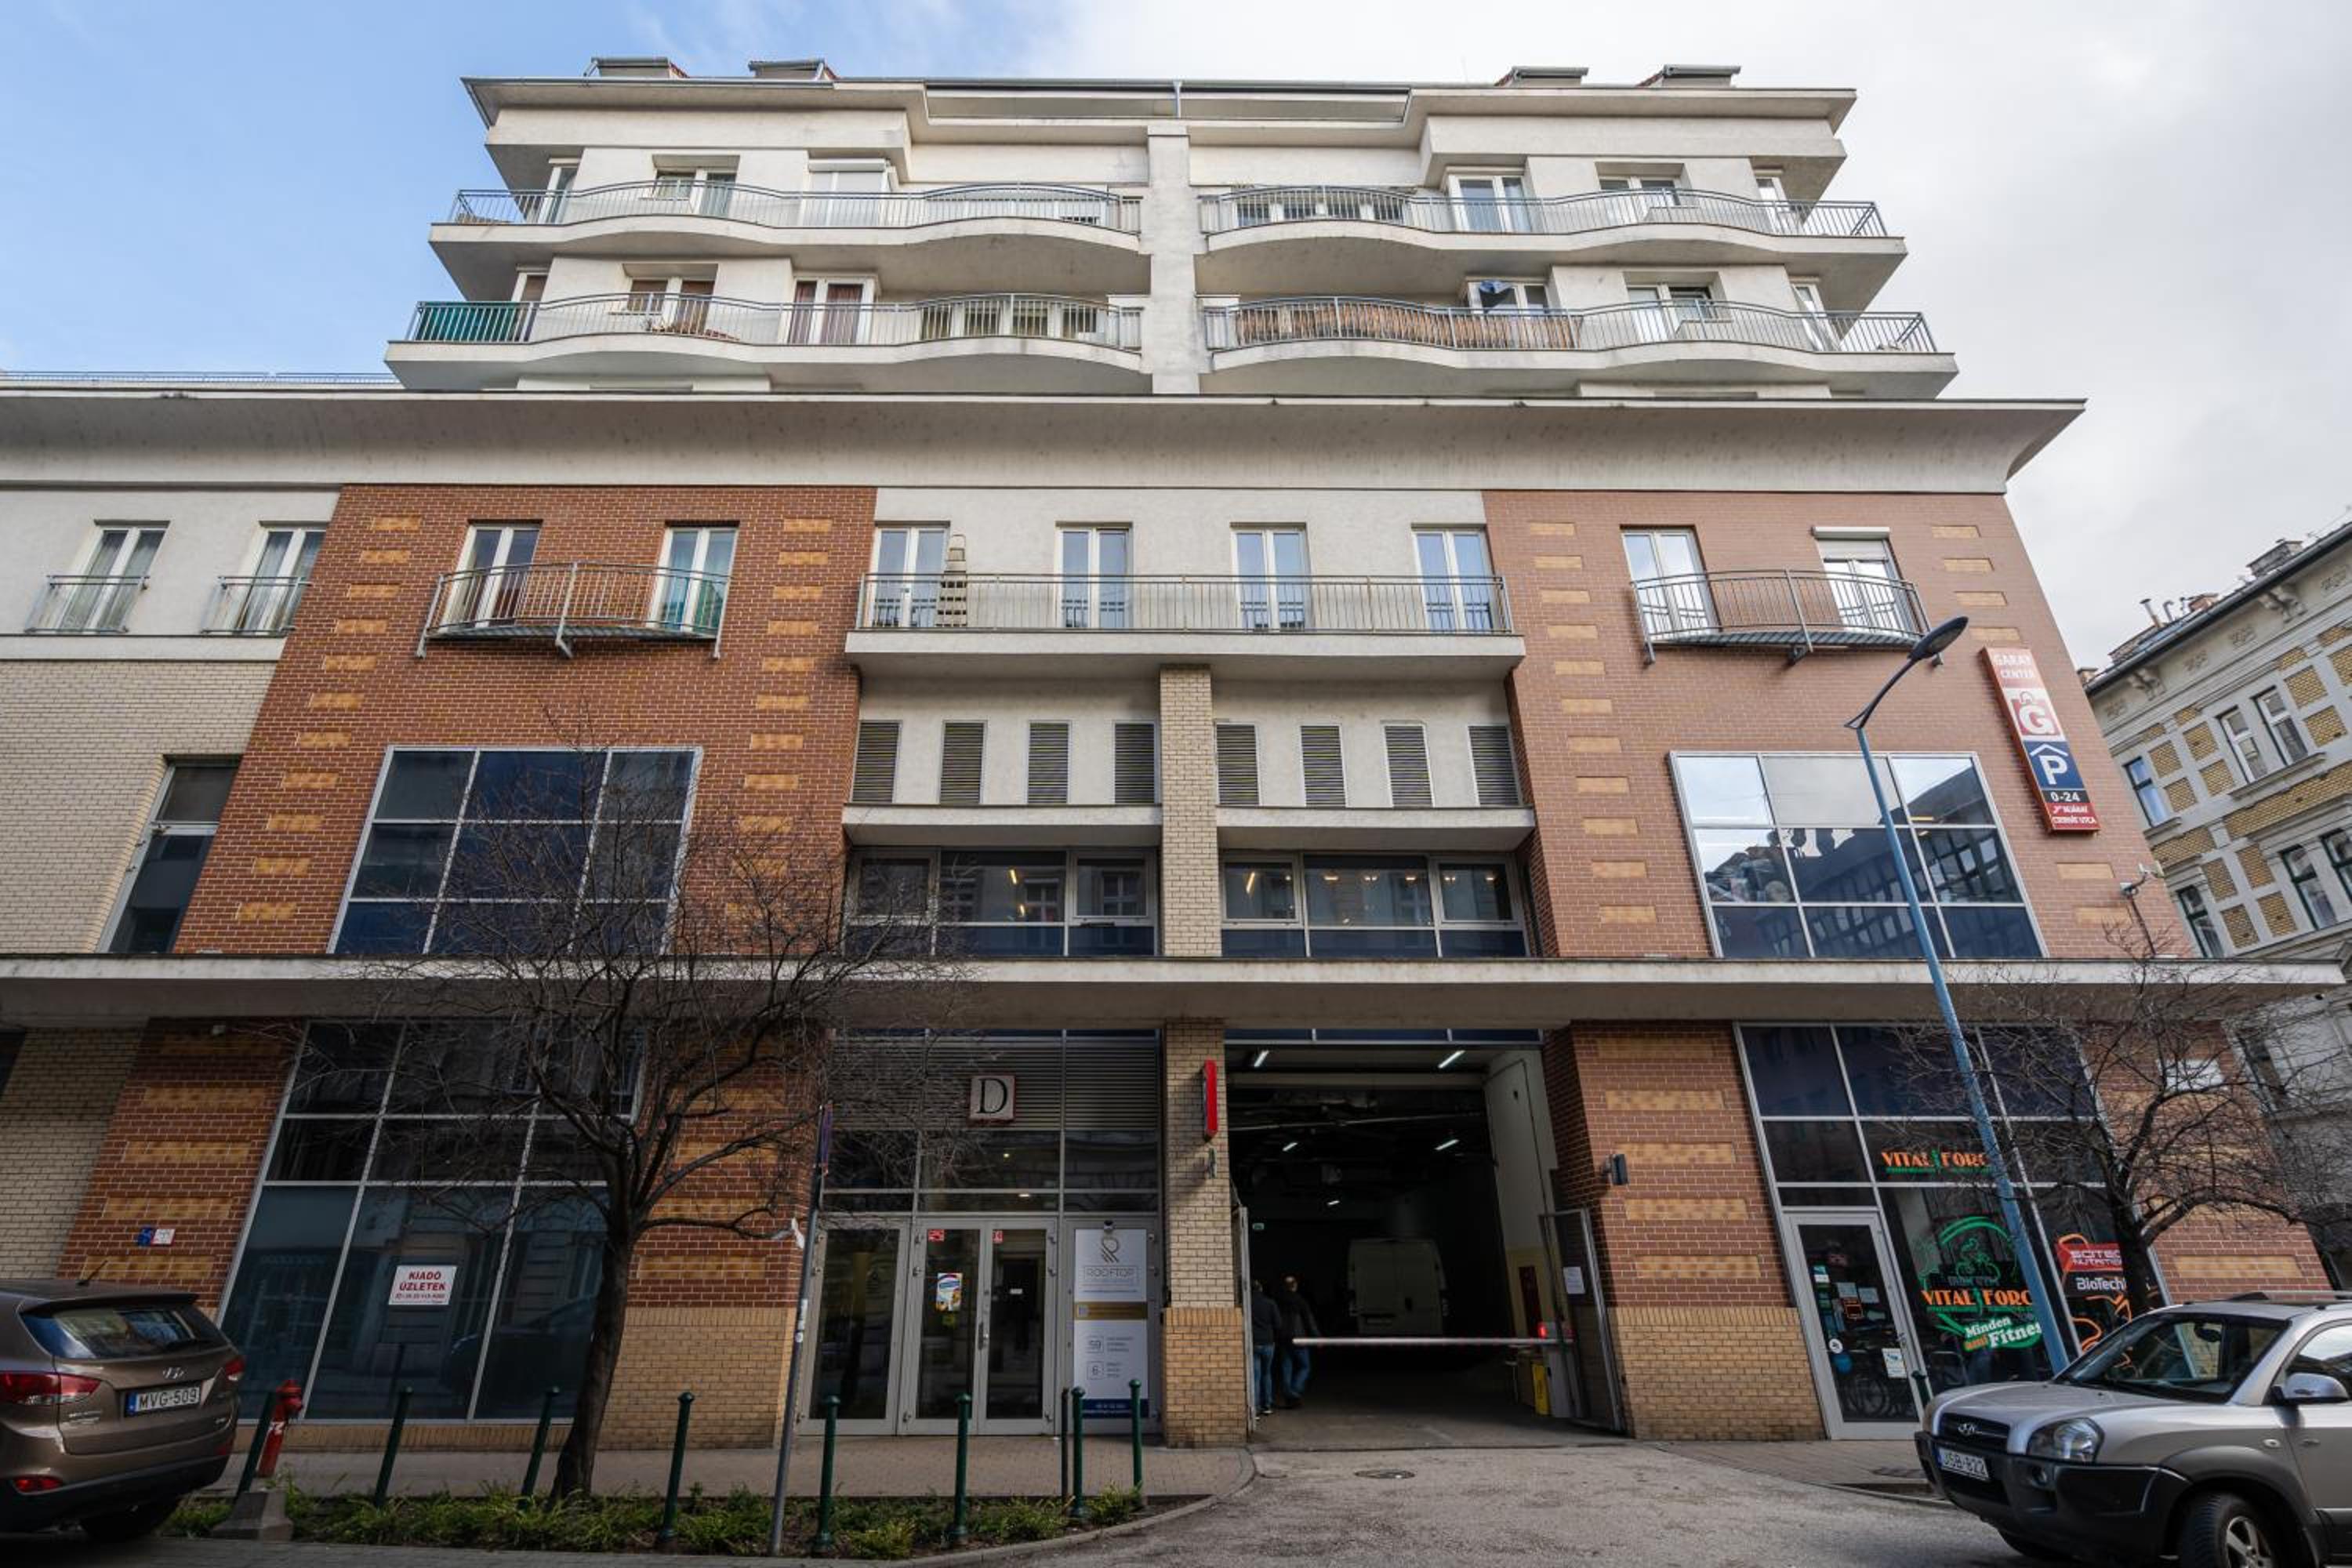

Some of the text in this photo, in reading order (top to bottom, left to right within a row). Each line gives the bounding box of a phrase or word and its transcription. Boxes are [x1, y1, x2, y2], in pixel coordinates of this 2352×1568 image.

[2039, 755, 2068, 785] P
[2050, 791, 2081, 802] 0-24
[976, 1078, 1007, 1114] D
[1882, 1152, 1931, 1167] VITAL
[408, 1270, 442, 1280] KIADÓ
[399, 1281, 446, 1291] ÜZLETEK
[2076, 1277, 2126, 1290] BioTech
[1921, 1290, 2033, 1305] VITAL FORC
[1964, 1316, 2011, 1338] Minden
[140, 1388, 201, 1412] MVG-509
